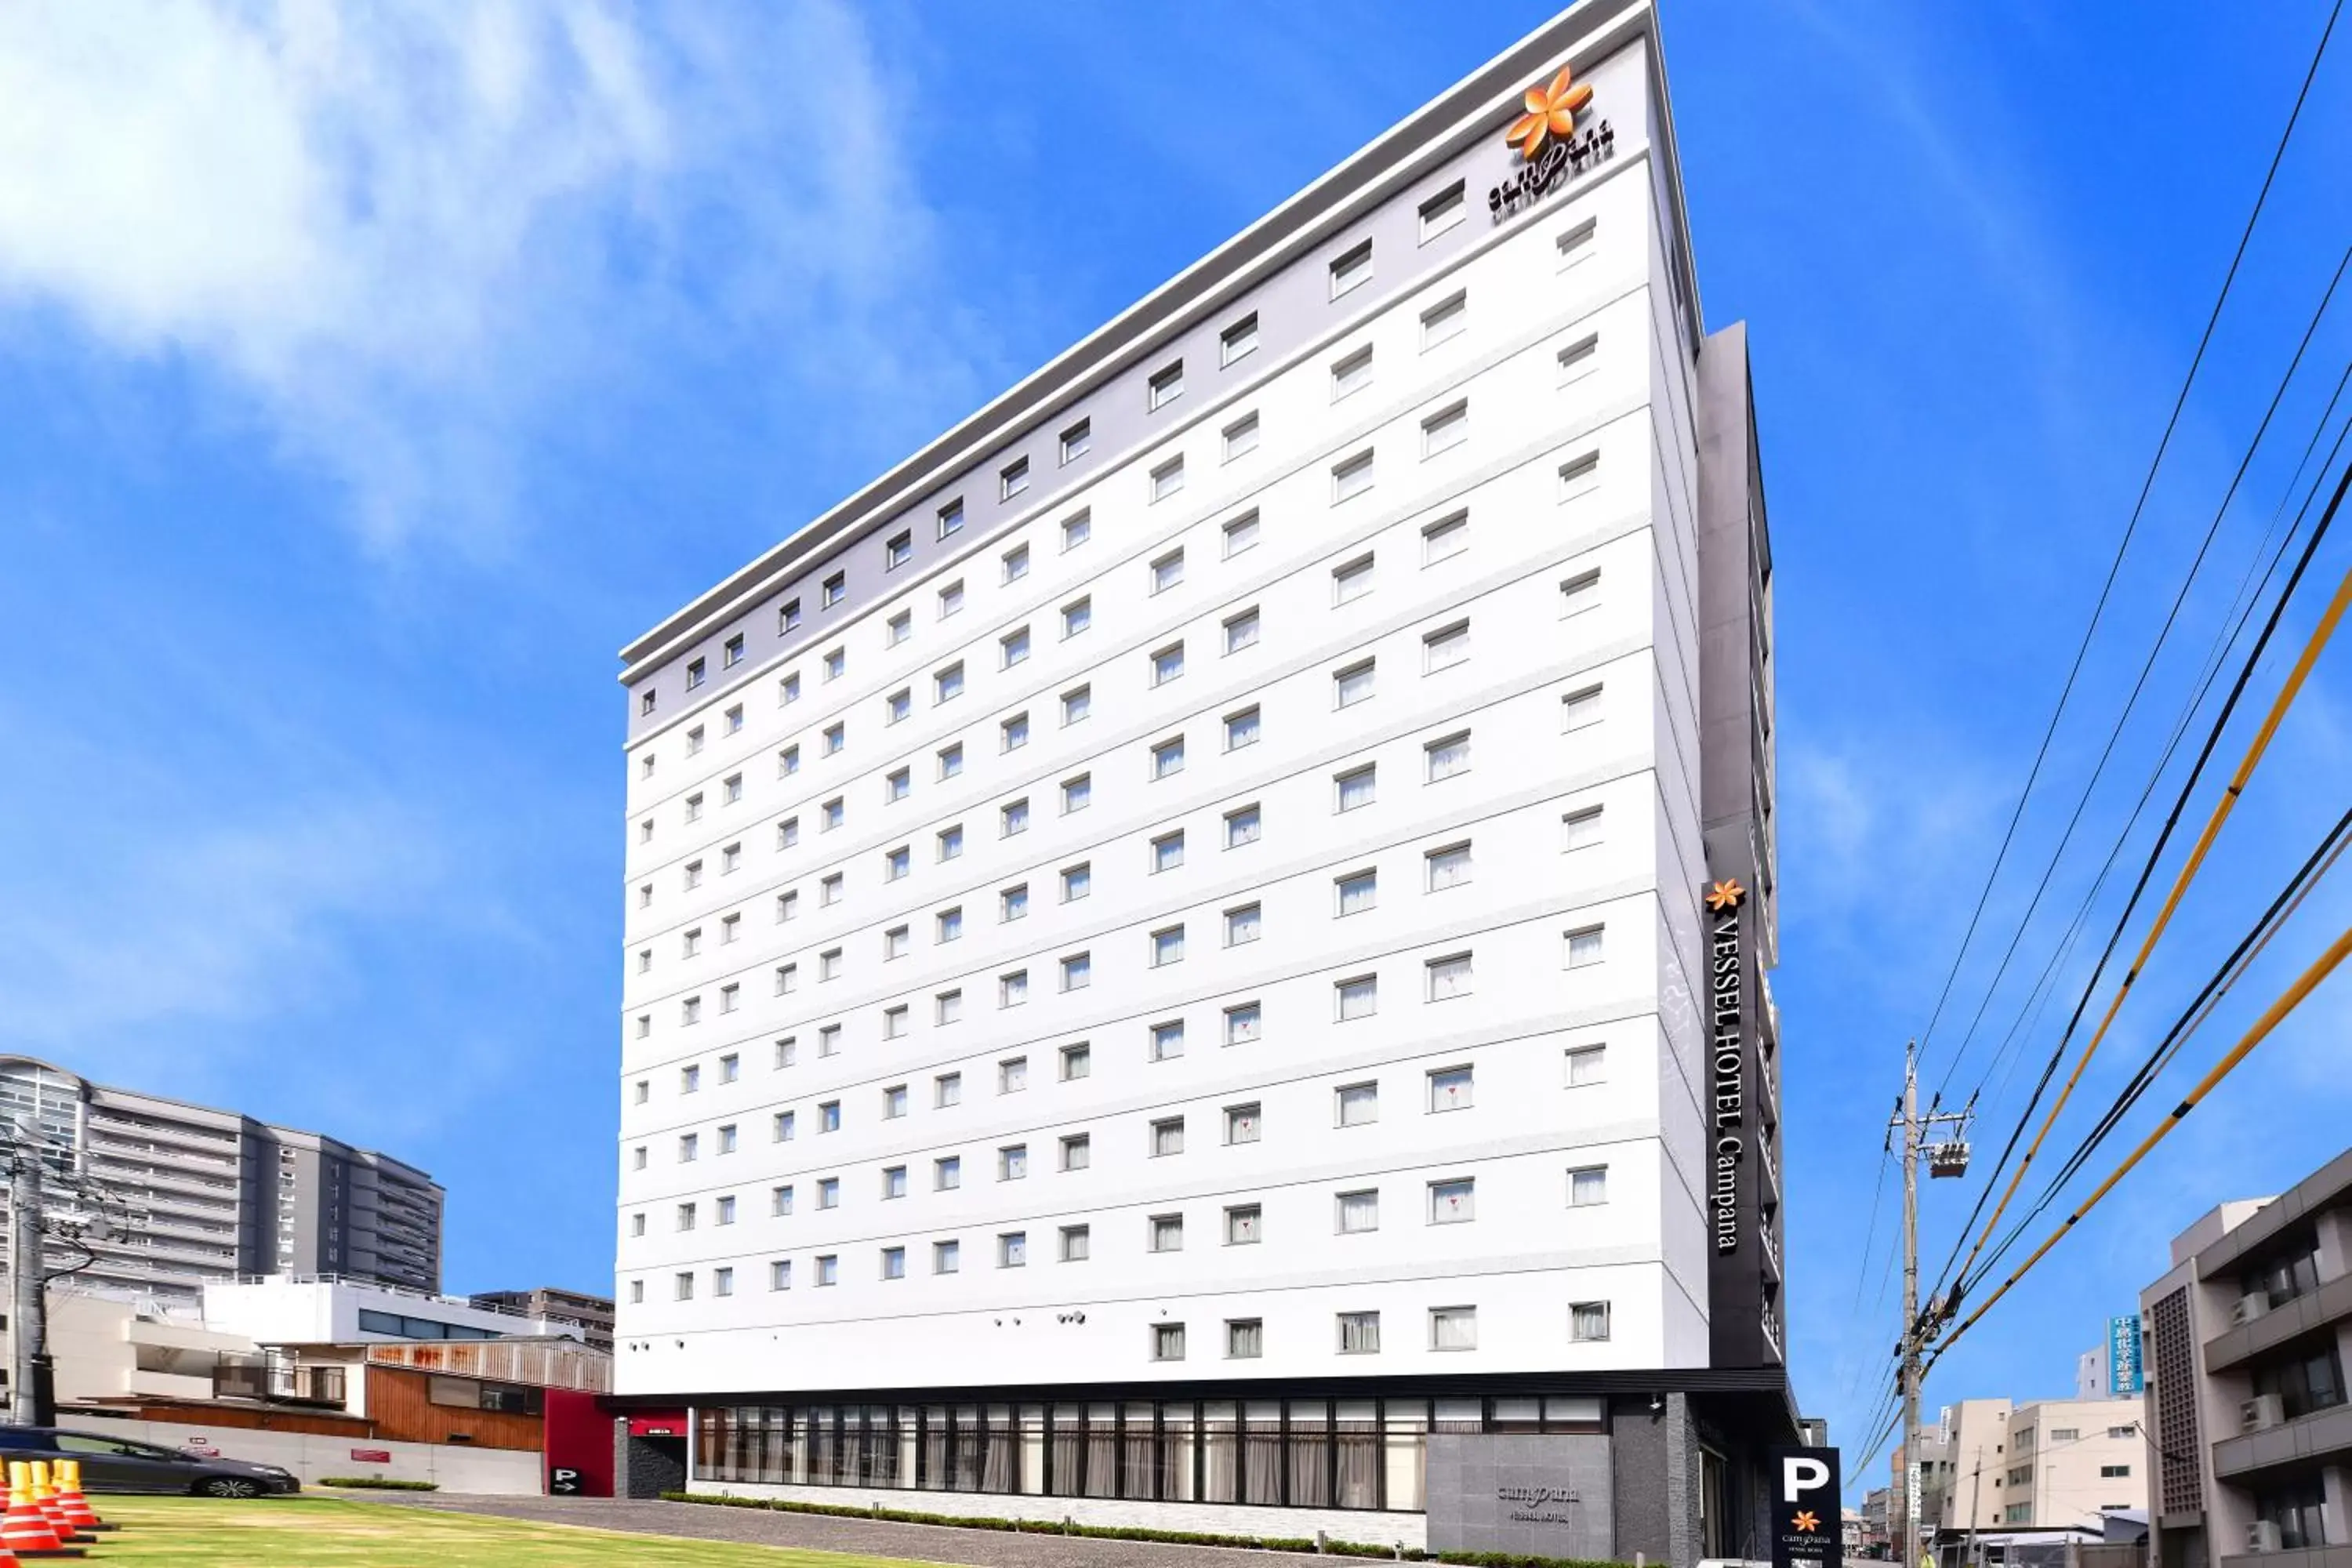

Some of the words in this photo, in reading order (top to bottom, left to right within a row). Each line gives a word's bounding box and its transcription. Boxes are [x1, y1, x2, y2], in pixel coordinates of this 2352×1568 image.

[1713, 916, 1740, 1026] VESSEL
[1715, 1033, 1742, 1128] HOTEL
[1710, 1136, 1743, 1249] Campana
[556, 1468, 578, 1481] P
[1783, 1457, 1830, 1503] P
